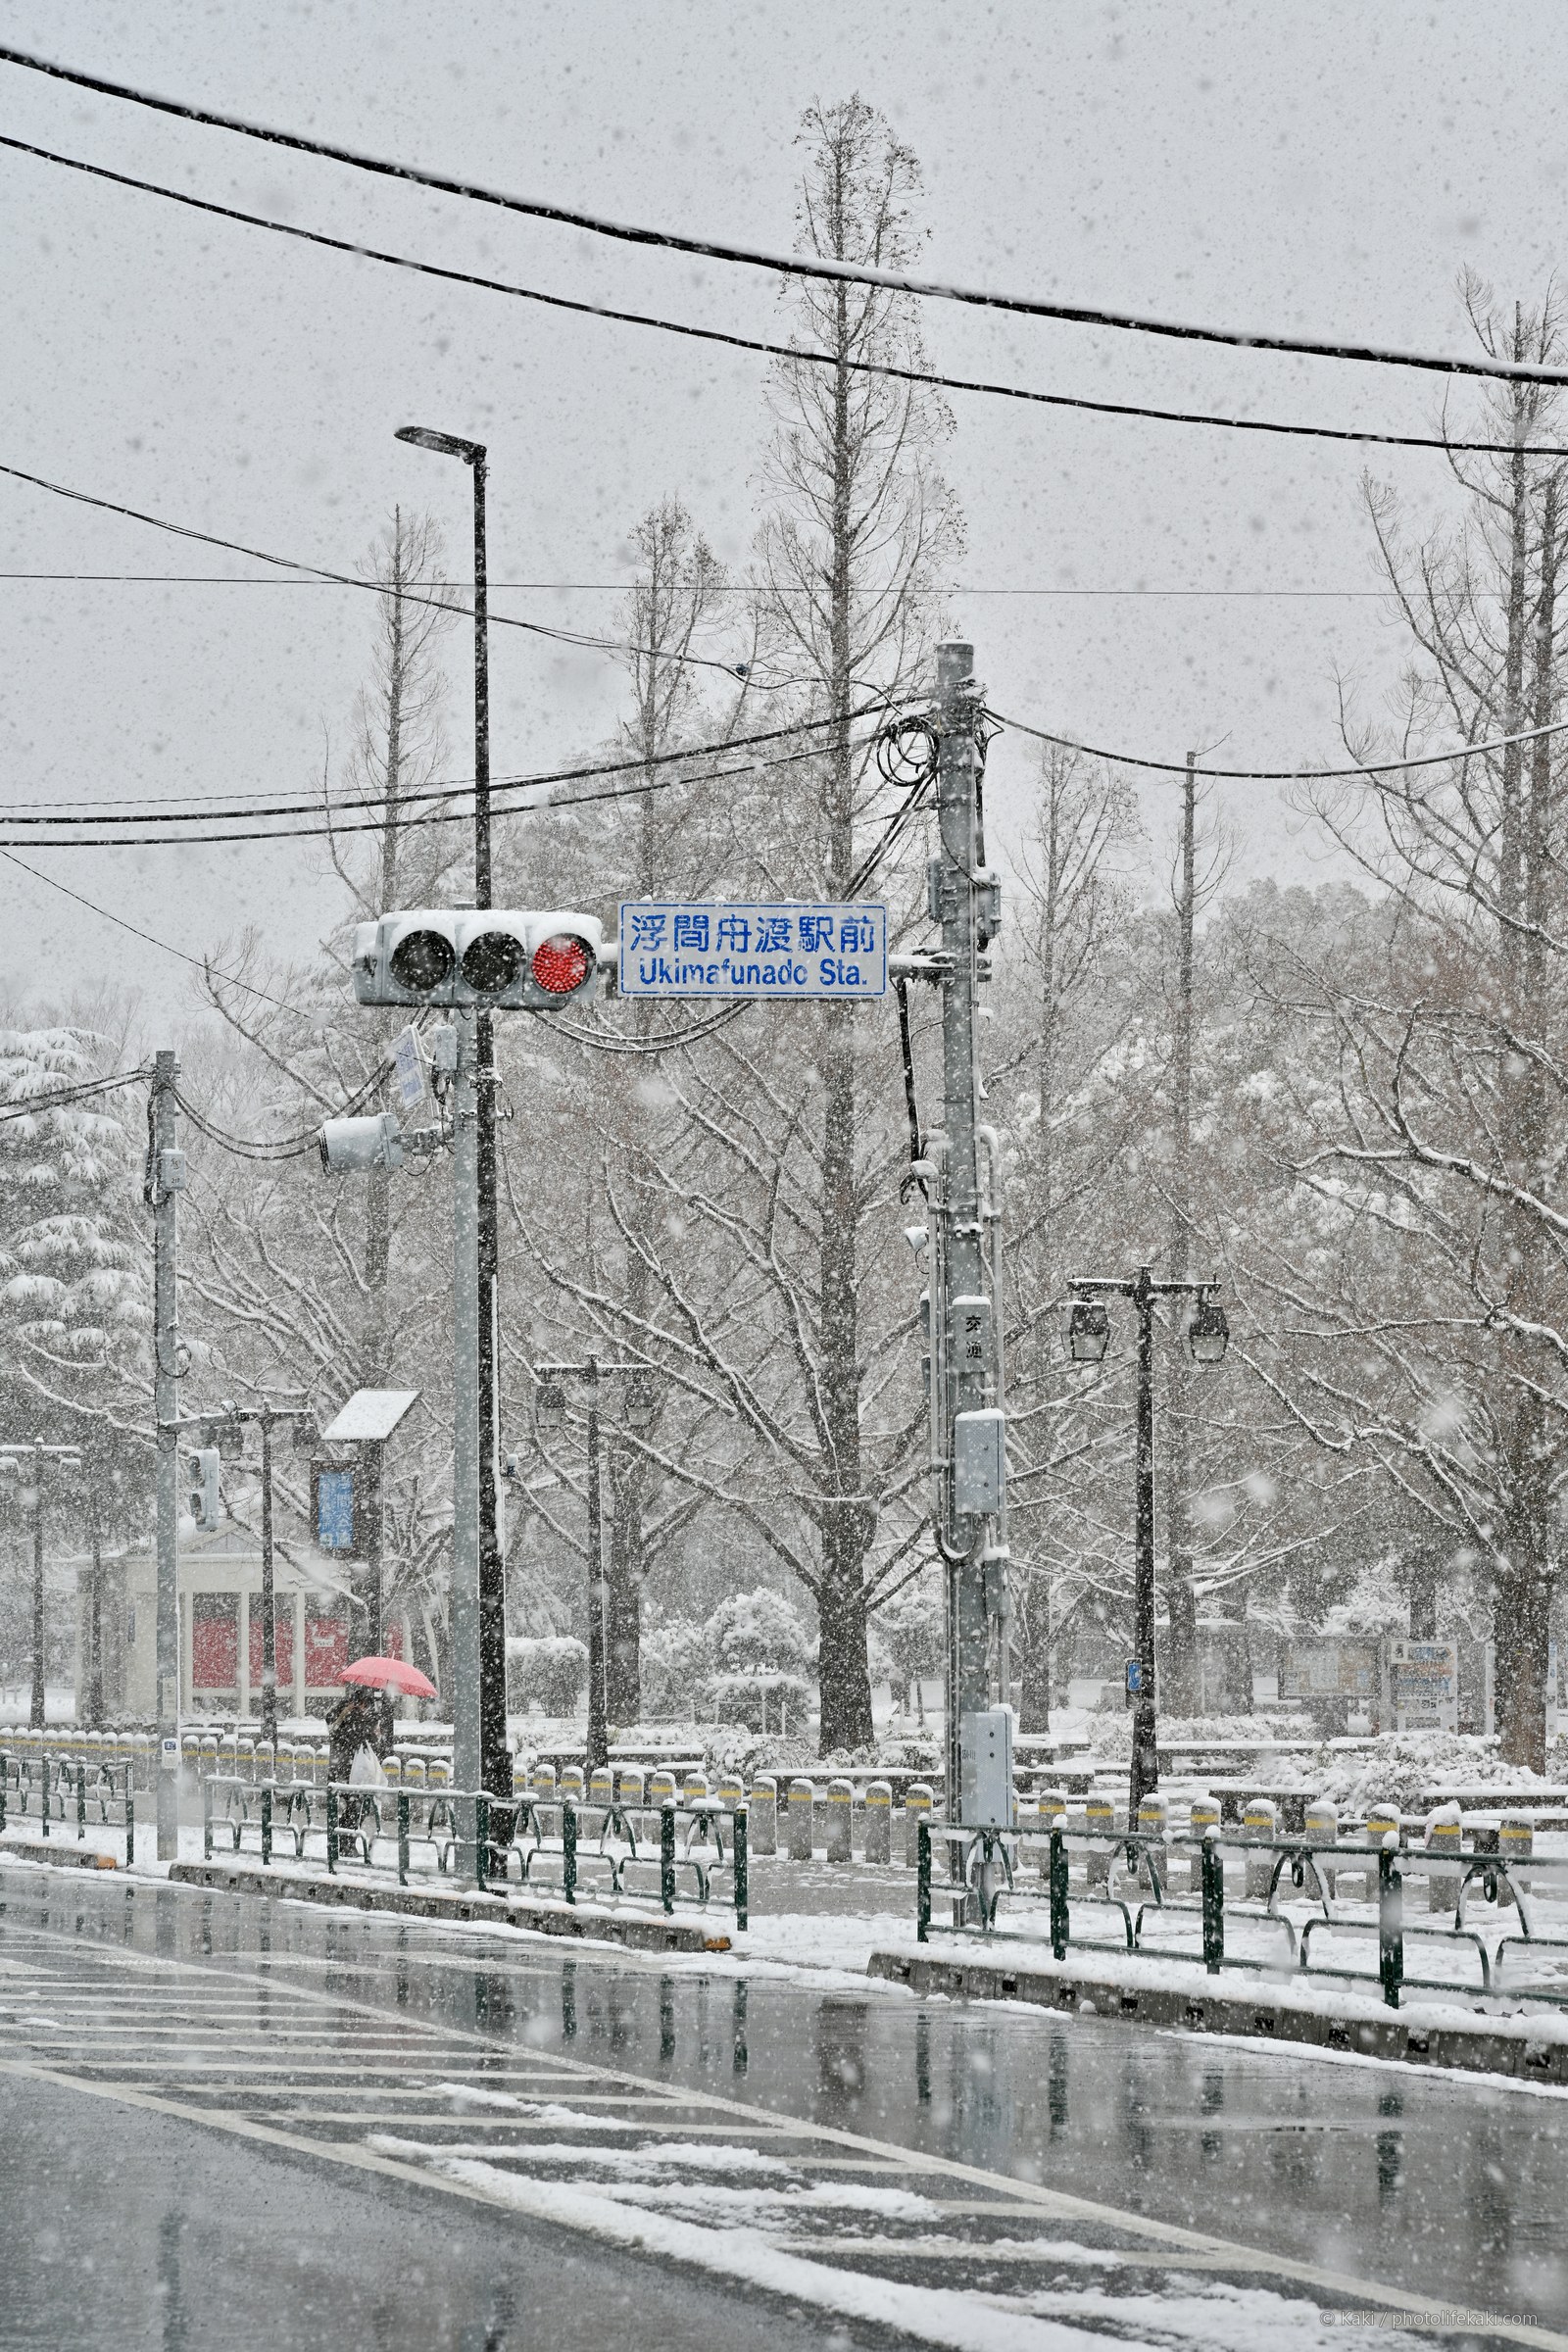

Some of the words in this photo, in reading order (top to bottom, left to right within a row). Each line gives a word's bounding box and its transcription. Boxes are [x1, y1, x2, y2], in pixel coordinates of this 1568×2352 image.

[630, 913, 875, 954] 浮間舟渡駅前
[640, 957, 808, 985] Ukimafunado
[819, 957, 867, 986] Sta.
[964, 1314, 983, 1359] 交通
